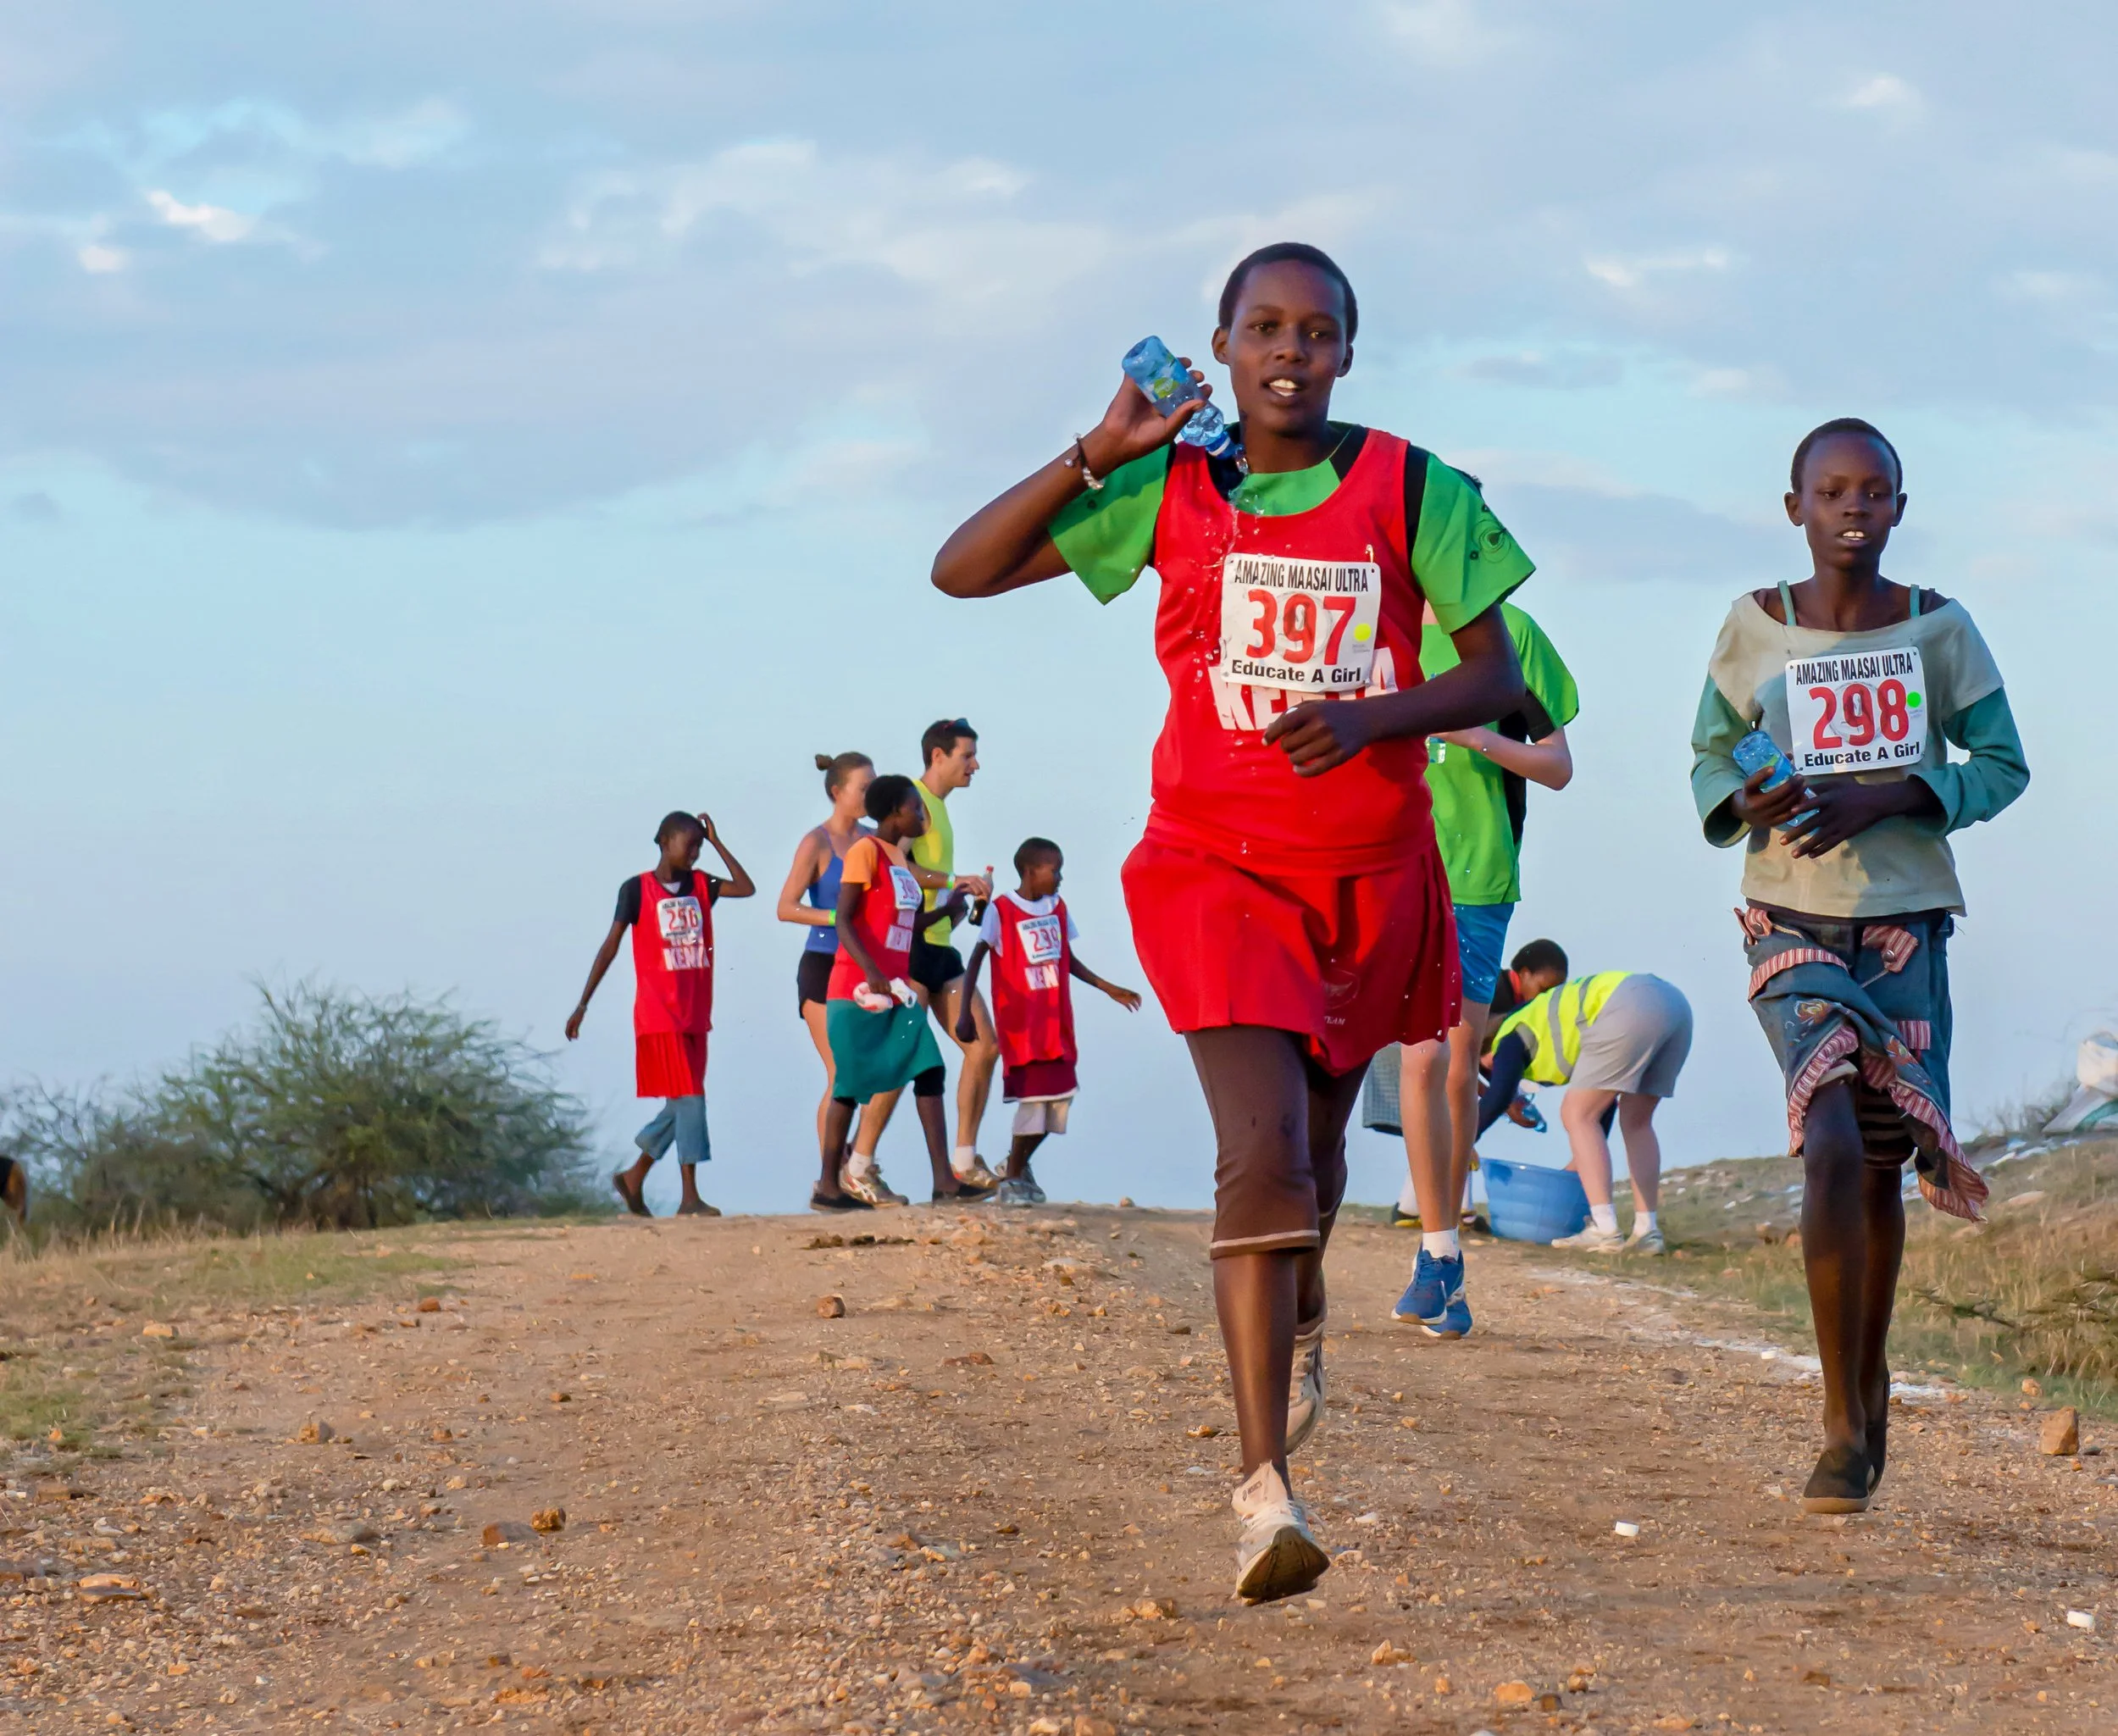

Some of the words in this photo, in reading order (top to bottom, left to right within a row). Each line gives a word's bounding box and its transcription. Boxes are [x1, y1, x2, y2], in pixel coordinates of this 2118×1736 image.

[1234, 560, 1284, 588] AMAZING
[1288, 565, 1332, 591] MAASAI
[1335, 568, 1368, 592] ULTRA
[1245, 589, 1356, 665] 397
[1232, 659, 1305, 682] Educate
[1311, 668, 1324, 683] A
[1331, 668, 1361, 684] Girl
[1796, 660, 1839, 685] AMAZING
[1841, 657, 1881, 680] MAASAI
[1883, 652, 1913, 676] ULTRA
[1808, 679, 1910, 750] 298
[1805, 749, 1871, 767] Educate
[1877, 746, 1889, 760] A
[1893, 741, 1921, 758] Girl
